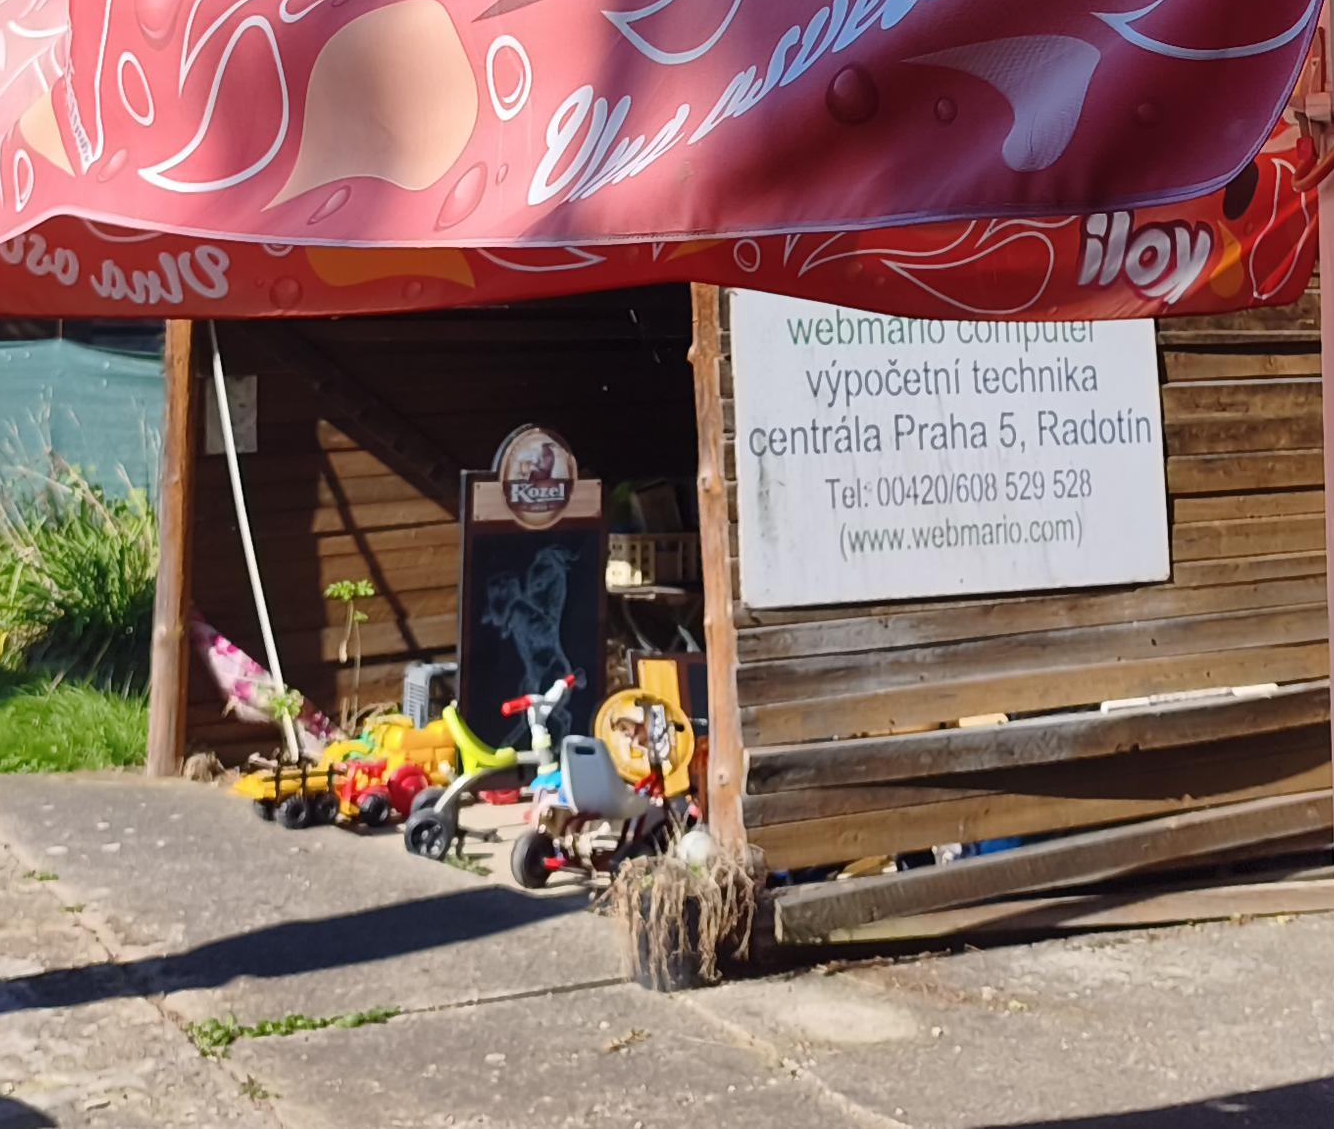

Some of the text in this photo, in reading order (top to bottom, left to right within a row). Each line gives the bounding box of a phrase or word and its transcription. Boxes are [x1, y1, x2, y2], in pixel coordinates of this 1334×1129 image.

[787, 308, 946, 346] webmario
[805, 357, 1099, 408] výpočetní technika
[748, 407, 1152, 457] centrála Praha 5, Radotín
[510, 482, 565, 504] Kozel
[825, 468, 1093, 509] Tel: 00420/608 529 528
[839, 510, 1083, 562] (www.webmario.com)
